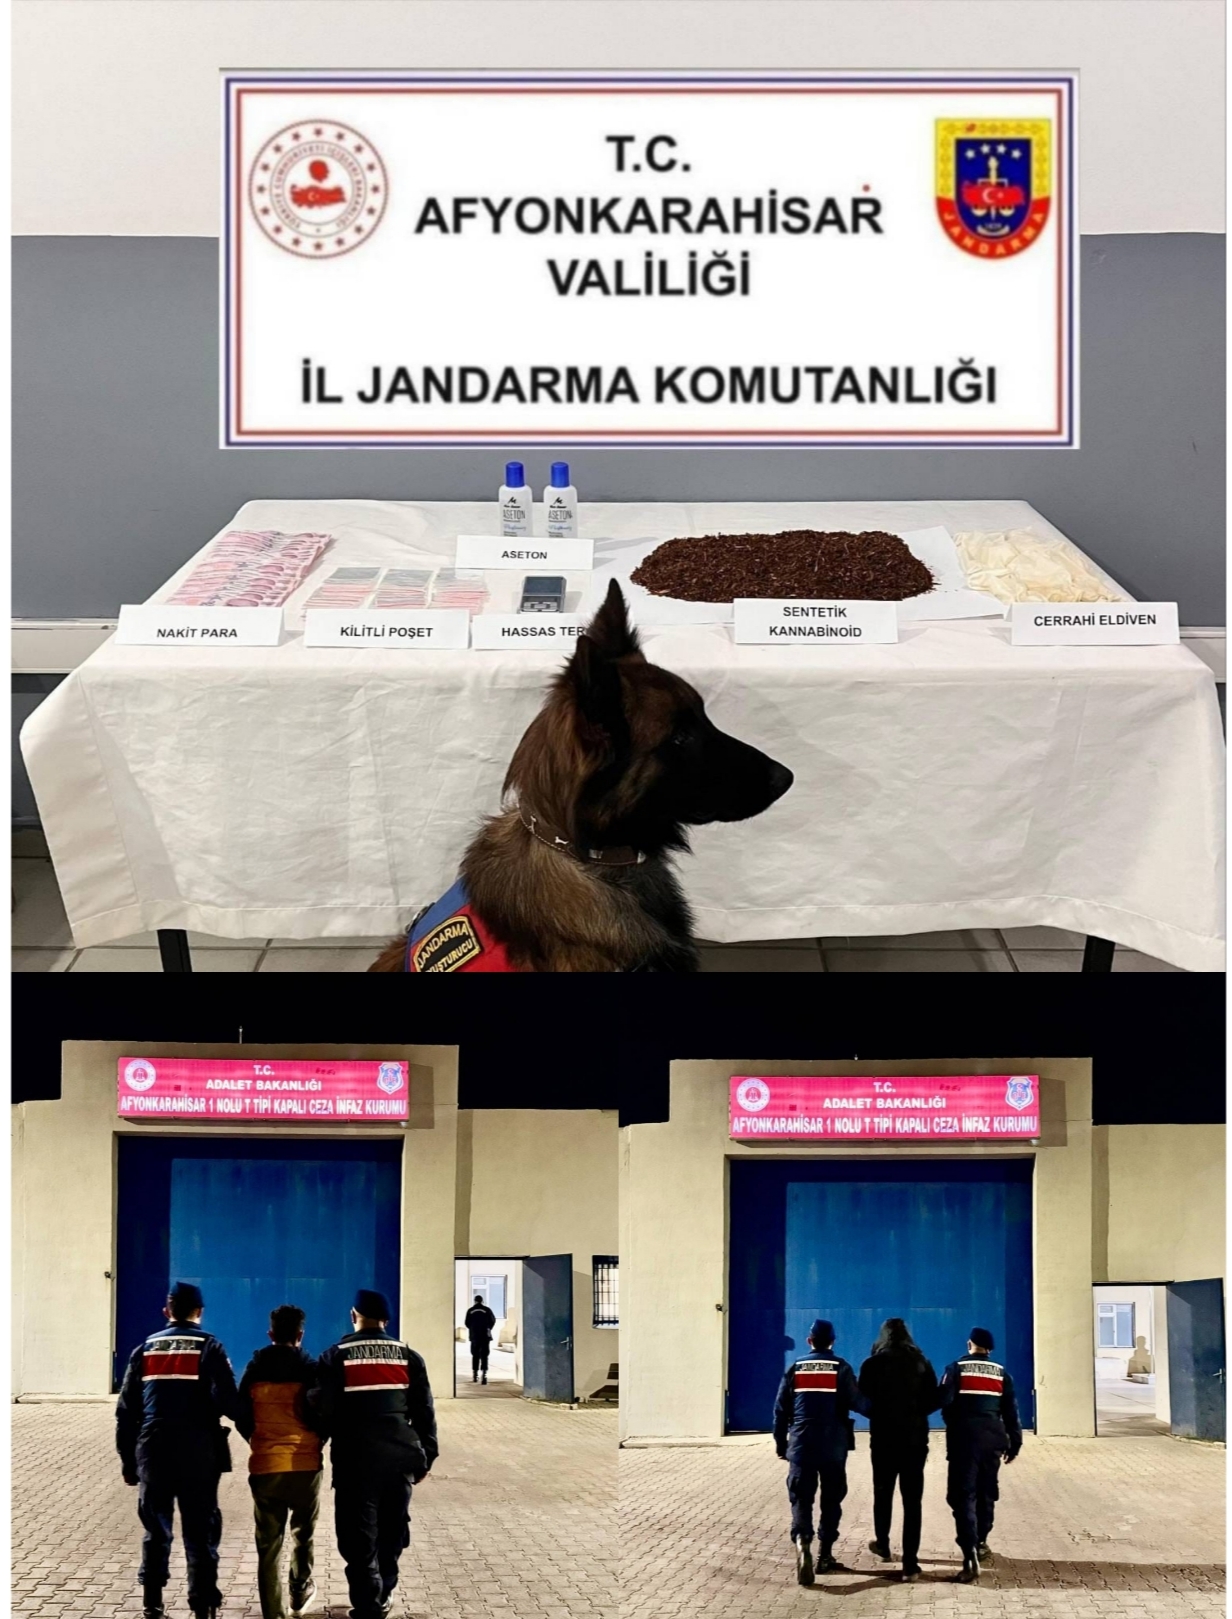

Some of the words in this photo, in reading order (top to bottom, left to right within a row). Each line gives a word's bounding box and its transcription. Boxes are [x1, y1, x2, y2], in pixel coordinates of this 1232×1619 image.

[501, 550, 548, 560] ASETON
[783, 604, 847, 618] SENTETİK
[1033, 612, 1096, 627] CERRAHİ
[1099, 612, 1157, 626] ELDİVEN
[157, 626, 197, 638] NAKİT
[201, 627, 238, 638] PARA
[340, 624, 385, 637] KİLİTLİ
[389, 626, 434, 641] POŞET
[501, 626, 556, 637] HASSAS
[769, 624, 862, 638] KANNABİNOİD
[417, 923, 469, 968] JANDARMA
[253, 1064, 275, 1076] T.C.
[205, 1079, 252, 1090] ADALET
[256, 1078, 322, 1091] BAKANLIĞI
[873, 1081, 897, 1093] T.C.
[120, 1094, 206, 1113] AFYONKARAHİSAR
[208, 1097, 214, 1112] 1
[216, 1098, 243, 1113] NOLU
[244, 1098, 251, 1113] T
[253, 1094, 271, 1113] TİPİ
[273, 1098, 306, 1114] KAPALI
[309, 1098, 334, 1115] CEZA
[336, 1095, 362, 1115] İNFAZ
[365, 1098, 406, 1115] KURUMU
[823, 1098, 872, 1109] ADALET
[876, 1096, 946, 1109] BAKANLIĞI
[732, 1114, 823, 1133] AFYONKARAHİSAR
[826, 1117, 832, 1133] 1
[834, 1117, 862, 1133] NOLU
[864, 1117, 870, 1133] T
[873, 1113, 893, 1133] TİPİ
[895, 1117, 930, 1133] KAPALI
[933, 1117, 959, 1133] CEZA
[962, 1113, 990, 1132] İNFAZ
[993, 1116, 1037, 1132] KURUMU
[347, 1344, 404, 1360] JANDARMA
